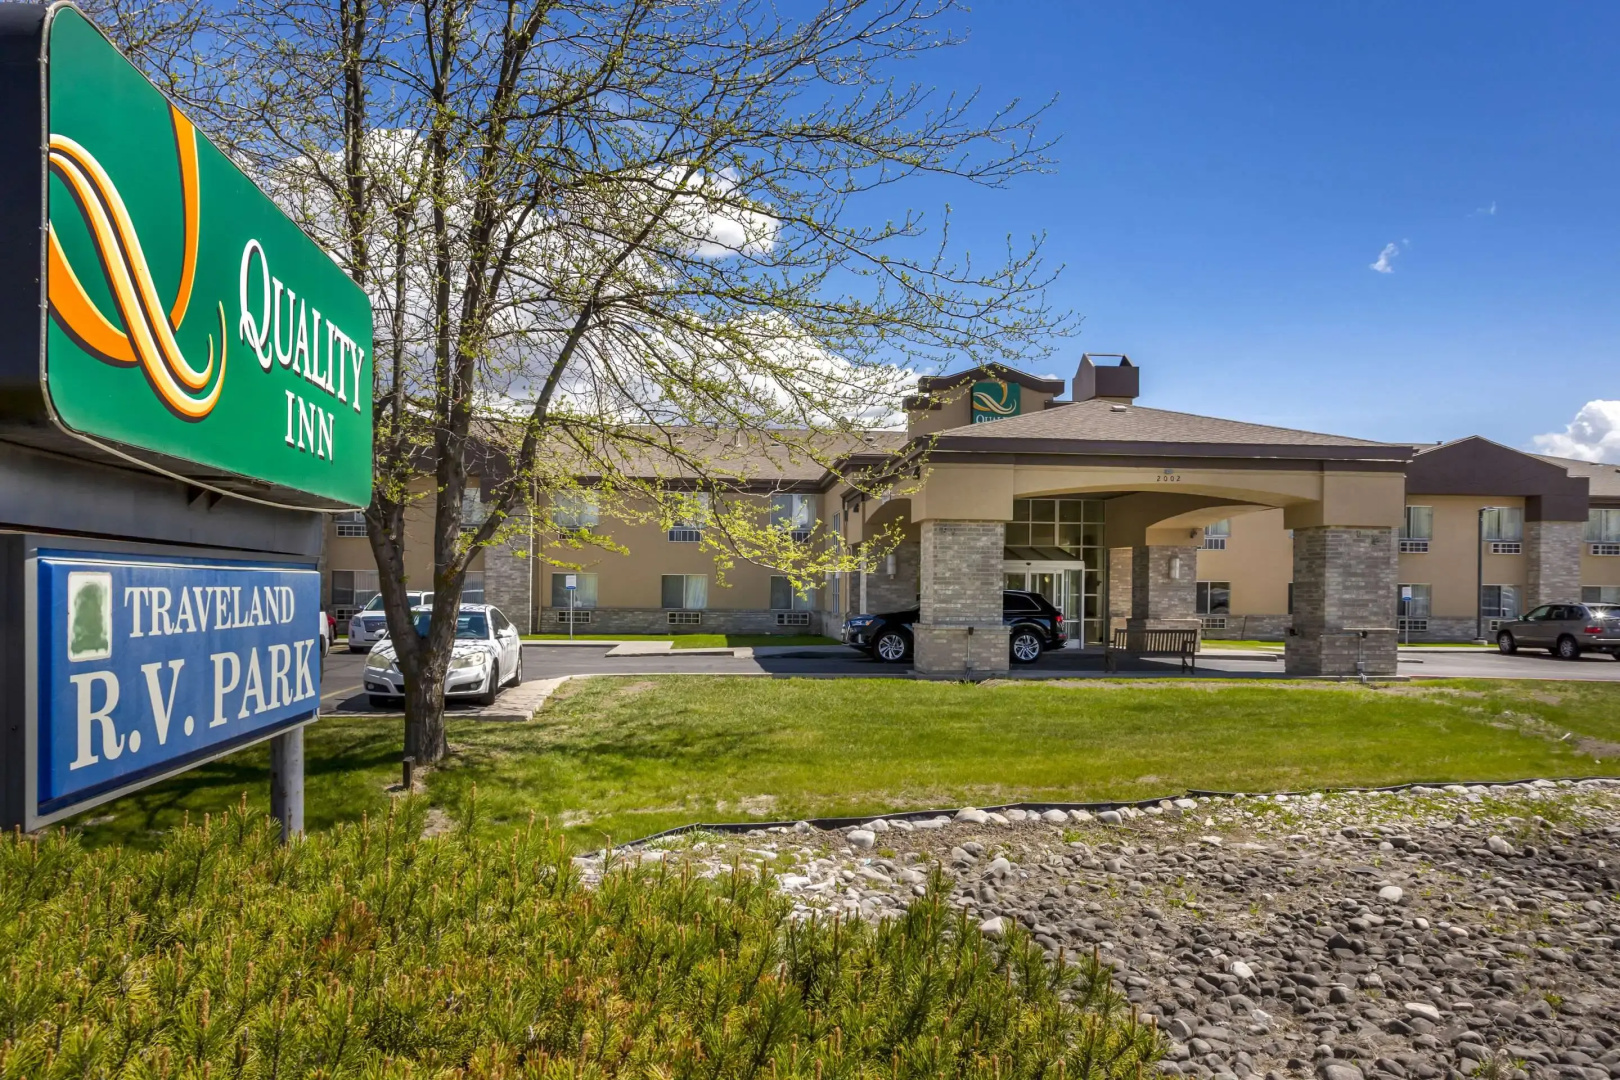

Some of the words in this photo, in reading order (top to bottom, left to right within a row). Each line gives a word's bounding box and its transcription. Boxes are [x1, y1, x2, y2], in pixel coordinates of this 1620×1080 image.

[239, 239, 365, 414] QUALITY
[284, 389, 335, 462] INN
[124, 586, 295, 638] TRAVELAND
[69, 658, 196, 771] R.V.
[209, 639, 316, 728] PARK
